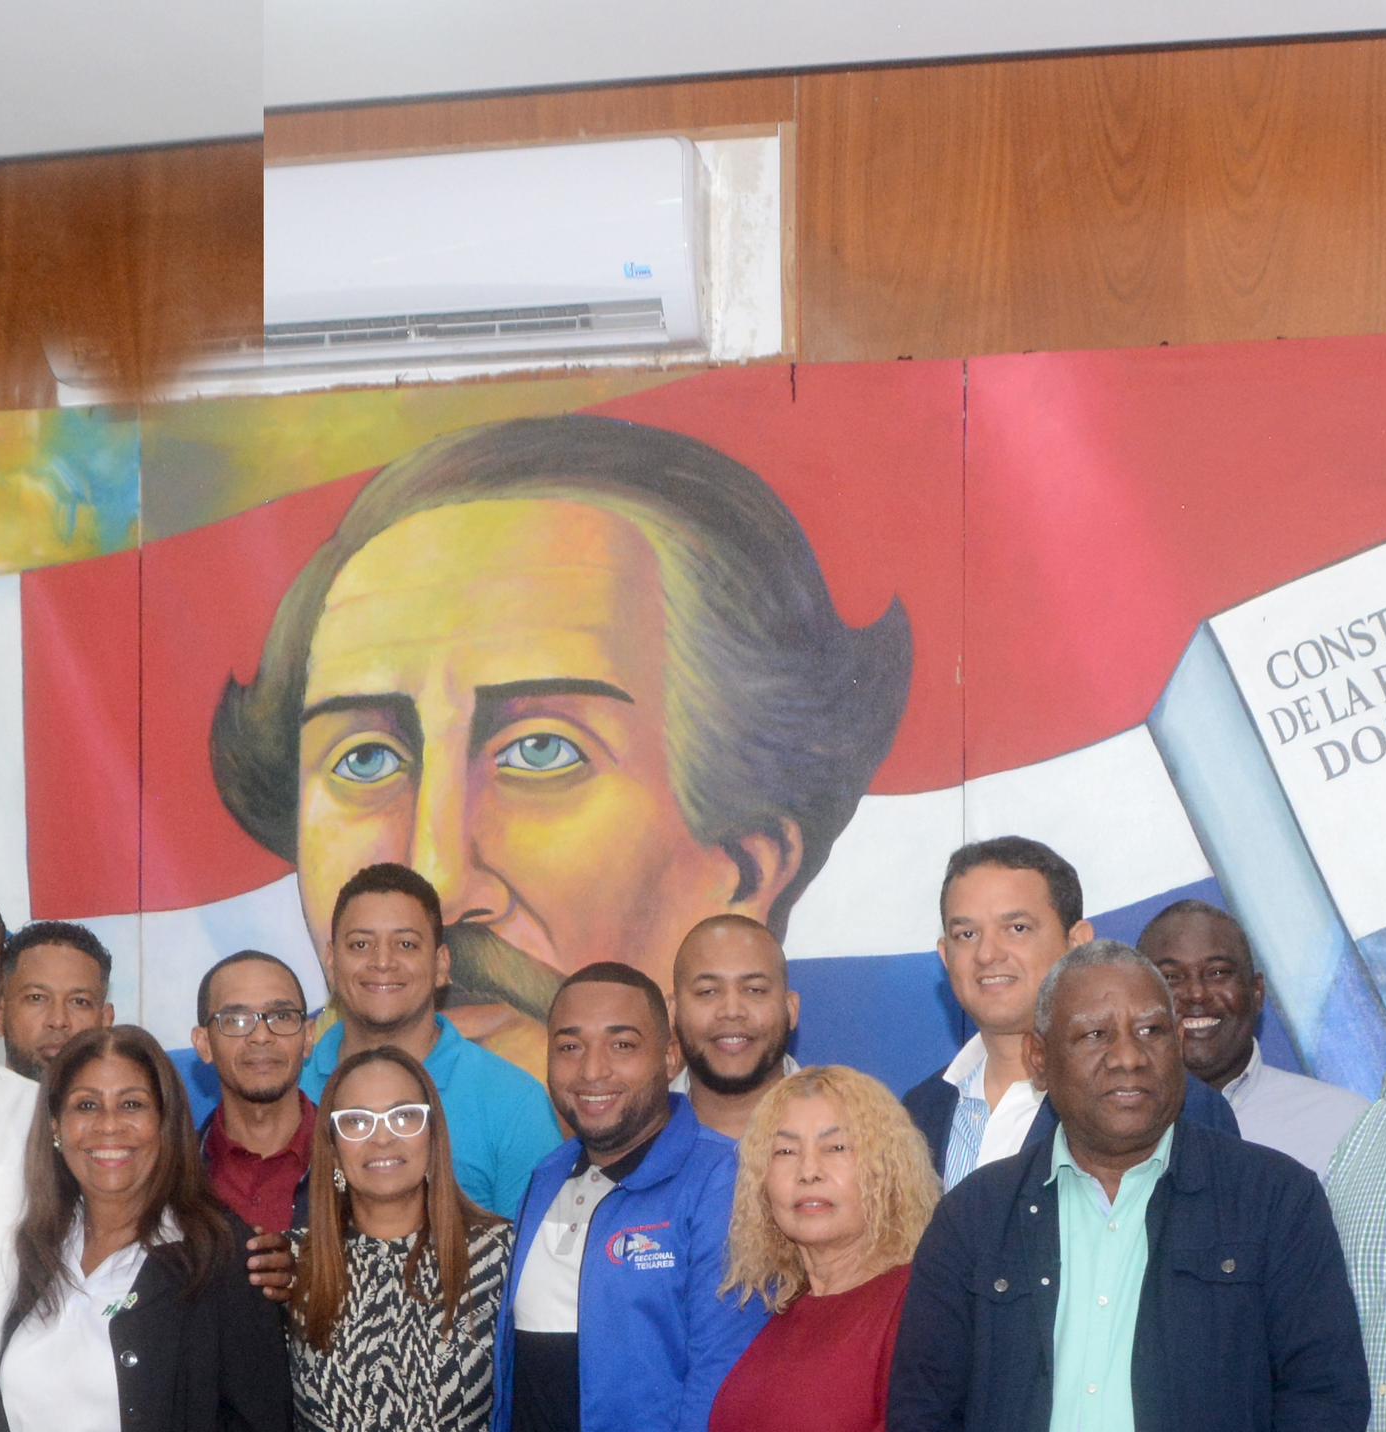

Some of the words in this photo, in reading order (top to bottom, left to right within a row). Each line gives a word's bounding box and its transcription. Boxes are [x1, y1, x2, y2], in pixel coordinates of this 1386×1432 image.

[1266, 695, 1321, 745] DE
[1317, 676, 1376, 725] LA
[634, 1251, 676, 1263] SECCIONAL
